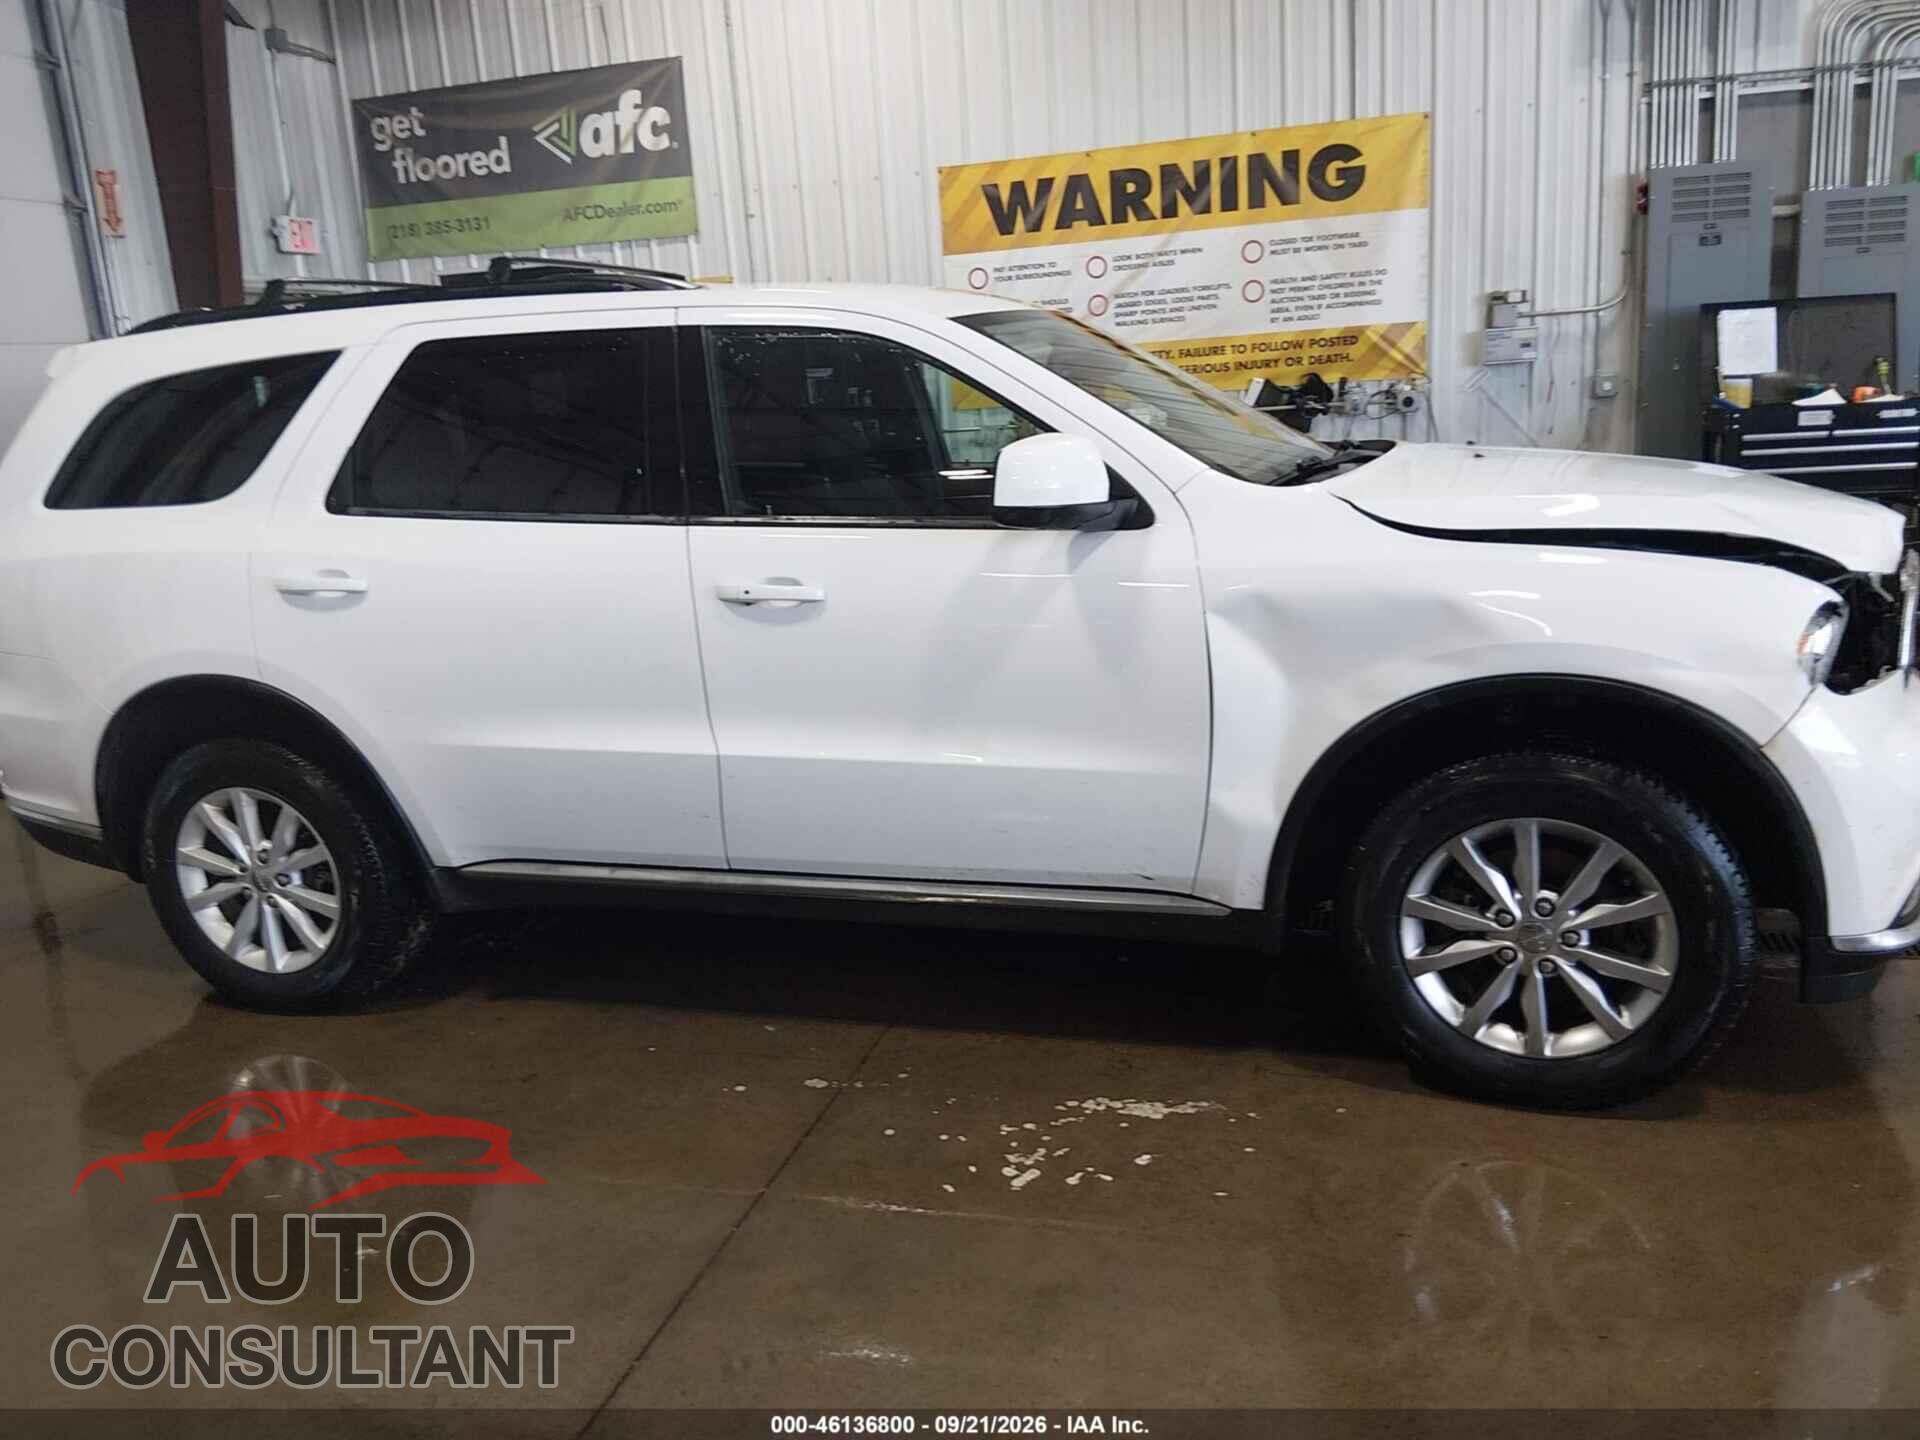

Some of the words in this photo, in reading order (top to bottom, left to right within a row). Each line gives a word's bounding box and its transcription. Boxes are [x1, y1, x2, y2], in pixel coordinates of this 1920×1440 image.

[370, 106, 427, 151] get
[579, 89, 672, 158] afc
[392, 136, 513, 184] floored
[562, 200, 680, 222] AFCDealer.com
[982, 143, 1366, 236] WARNING
[1178, 345, 1227, 359] FAILURE
[1230, 343, 1248, 355] TO
[1251, 339, 1307, 353] FOLLOW
[1309, 335, 1359, 349] POSTED
[1234, 357, 1281, 371] INJURY
[1284, 355, 1304, 367] OR
[1308, 353, 1354, 366] DEATH.
